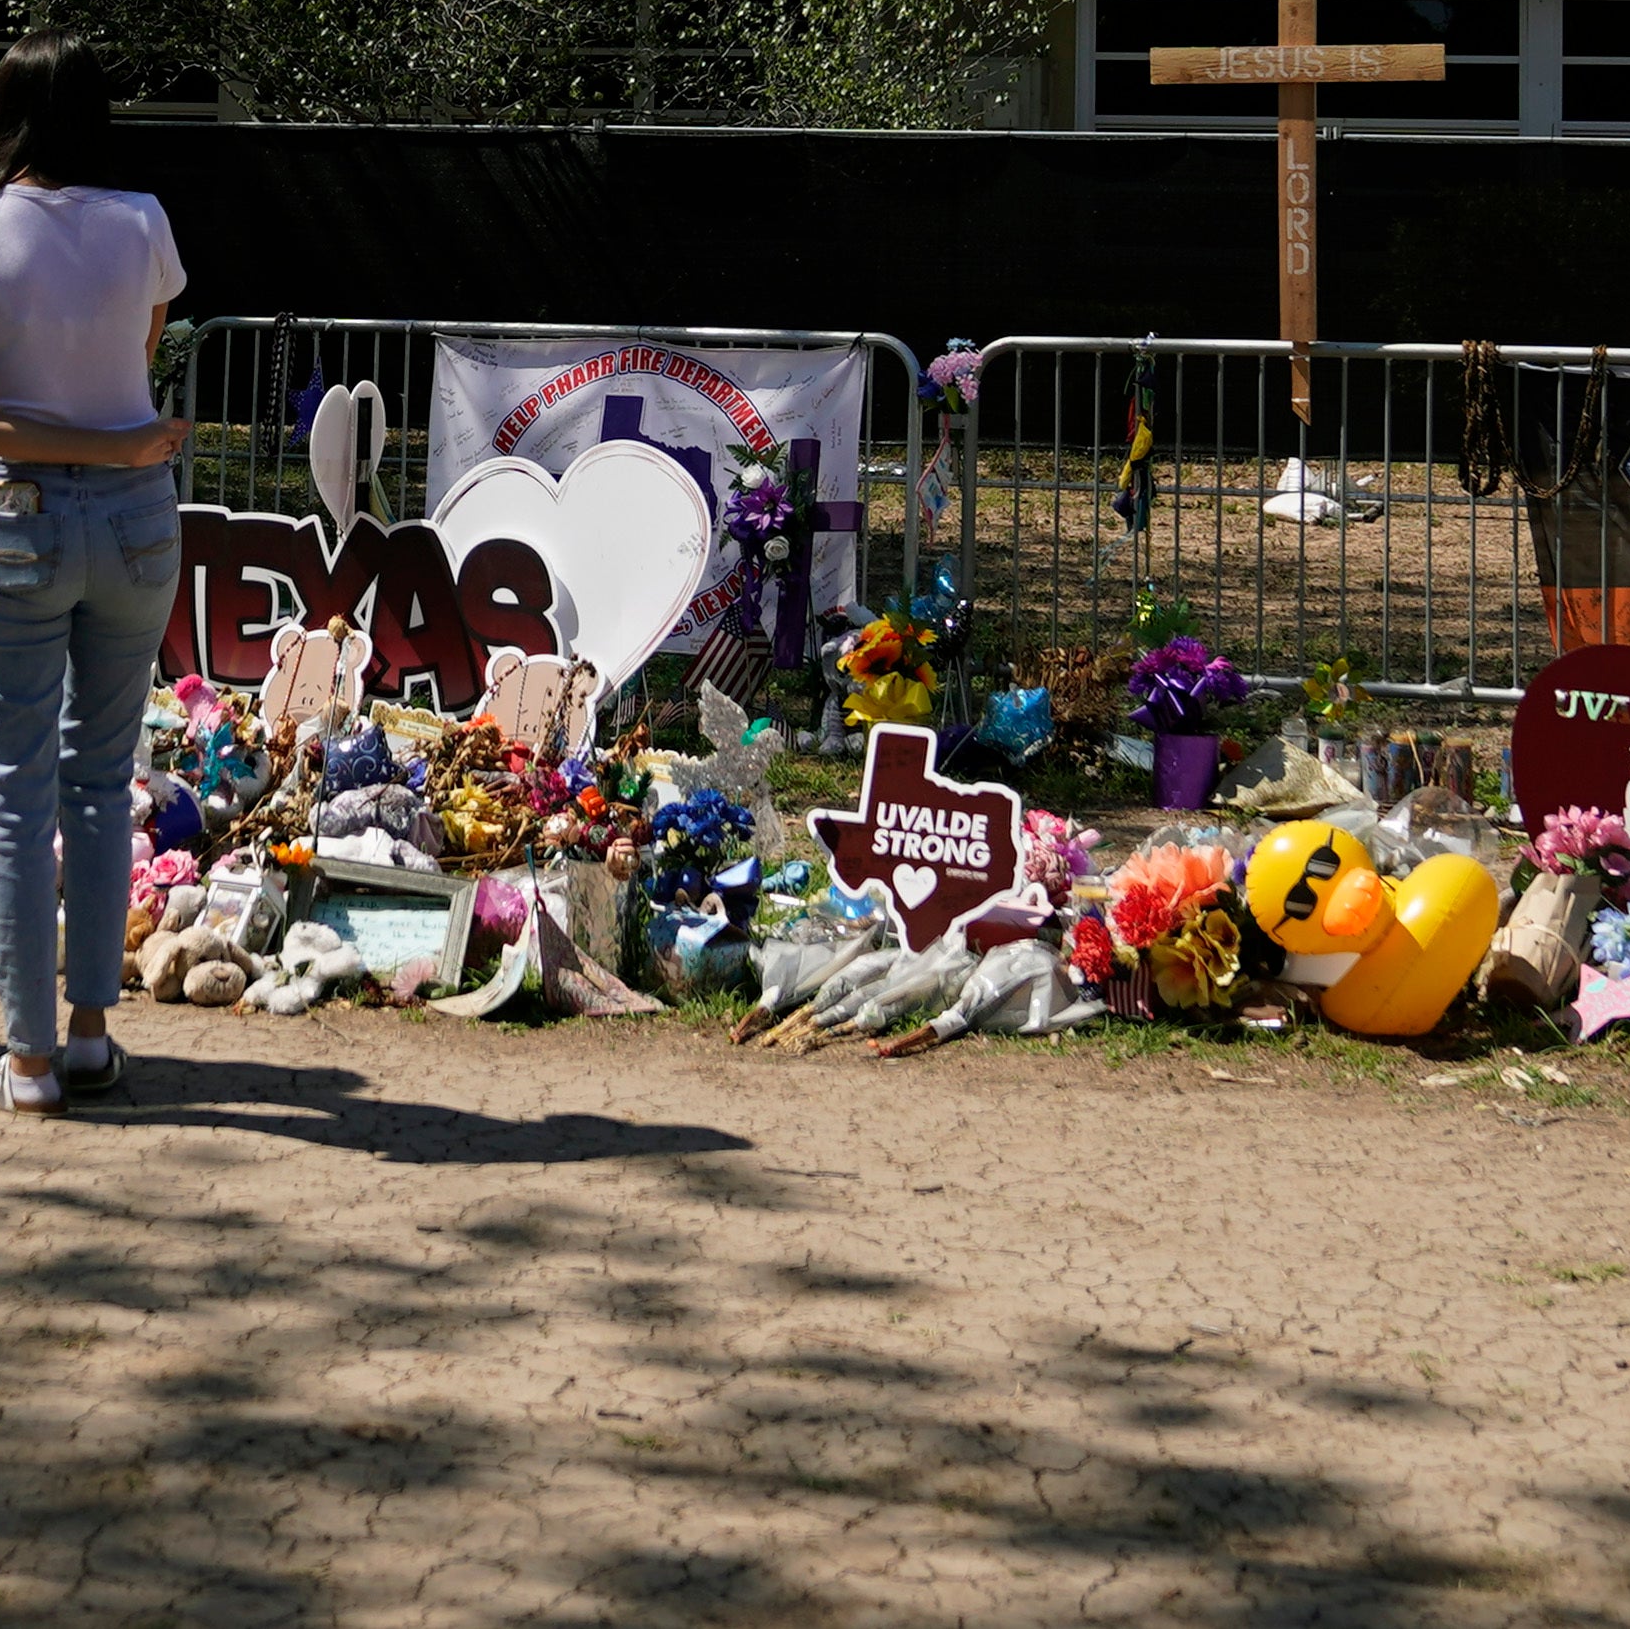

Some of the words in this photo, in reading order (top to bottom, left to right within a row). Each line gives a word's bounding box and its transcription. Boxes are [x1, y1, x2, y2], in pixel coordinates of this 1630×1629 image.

[1205, 47, 1325, 80] JESUS
[1350, 46, 1382, 78] IS
[1285, 137, 1310, 275] LORD
[494, 397, 540, 454] HELP
[542, 354, 616, 404] PHARR
[620, 348, 667, 372] FIRE
[156, 504, 562, 720] TEXAS
[871, 828, 992, 868] STRONG
[876, 801, 989, 841] UVALDE
